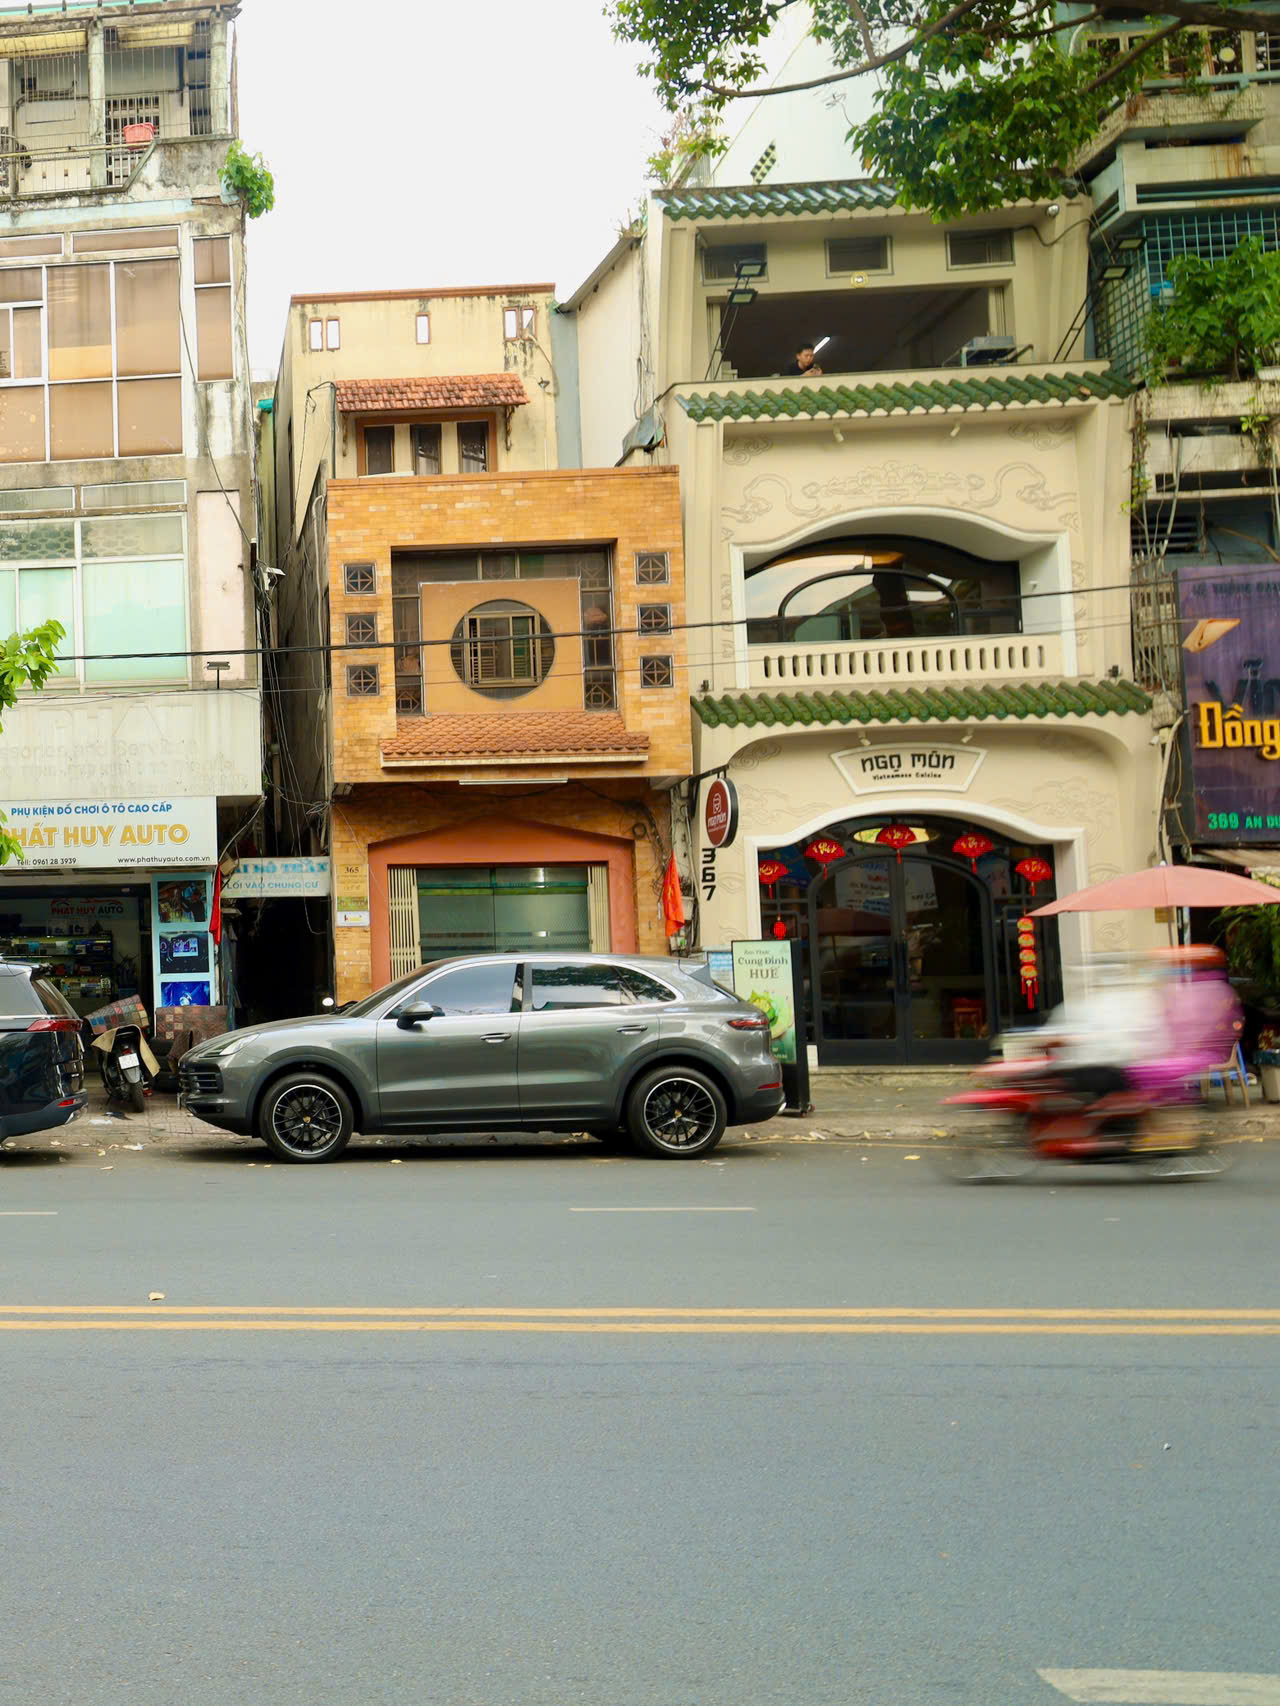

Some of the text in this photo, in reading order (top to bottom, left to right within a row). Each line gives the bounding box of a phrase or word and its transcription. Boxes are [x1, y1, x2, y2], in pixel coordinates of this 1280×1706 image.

[11, 807, 30, 819] PHỤ
[32, 805, 55, 818] KIỆN
[74, 804, 100, 815] CHƠI
[101, 802, 110, 814] Ô
[111, 802, 126, 814] TÔ
[127, 804, 150, 813] CAO
[151, 800, 173, 813] CẤP
[63, 824, 116, 848] HUY
[119, 823, 191, 846] AUTO
[32, 858, 48, 866] 0961
[50, 858, 59, 866] 28
[60, 857, 77, 866] 3939
[117, 855, 211, 864] www.phathuyauto.com.vn
[344, 866, 360, 874] 365
[702, 848, 716, 901] 367
[98, 905, 124, 914] AUTO
[738, 956, 763, 967] Cung
